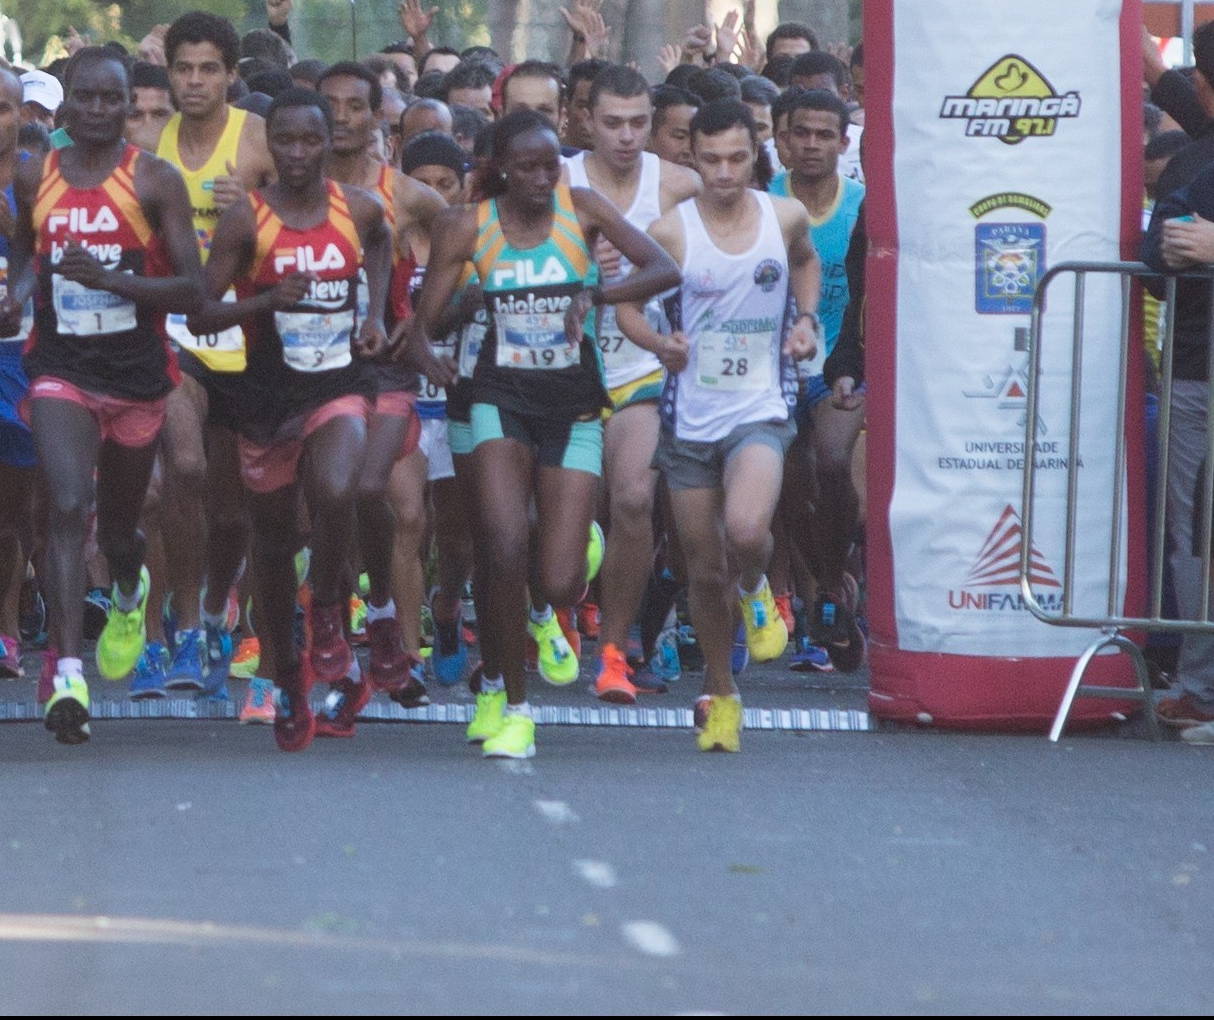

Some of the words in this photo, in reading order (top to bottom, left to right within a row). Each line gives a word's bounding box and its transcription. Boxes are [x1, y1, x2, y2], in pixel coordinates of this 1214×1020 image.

[940, 91, 1081, 117] MARINGÁ
[967, 118, 1010, 136] FM
[1014, 117, 1055, 135] 97.1
[48, 205, 120, 234] FILA
[274, 243, 346, 274] FILA
[493, 256, 568, 287] FILA
[93, 312, 102, 331] 1
[529, 348, 556, 365] 19
[721, 357, 749, 377] 28
[965, 441, 1059, 454] UNIVERSIADE
[938, 457, 1003, 470] ESTADUAL
[1007, 458, 1024, 470] DE
